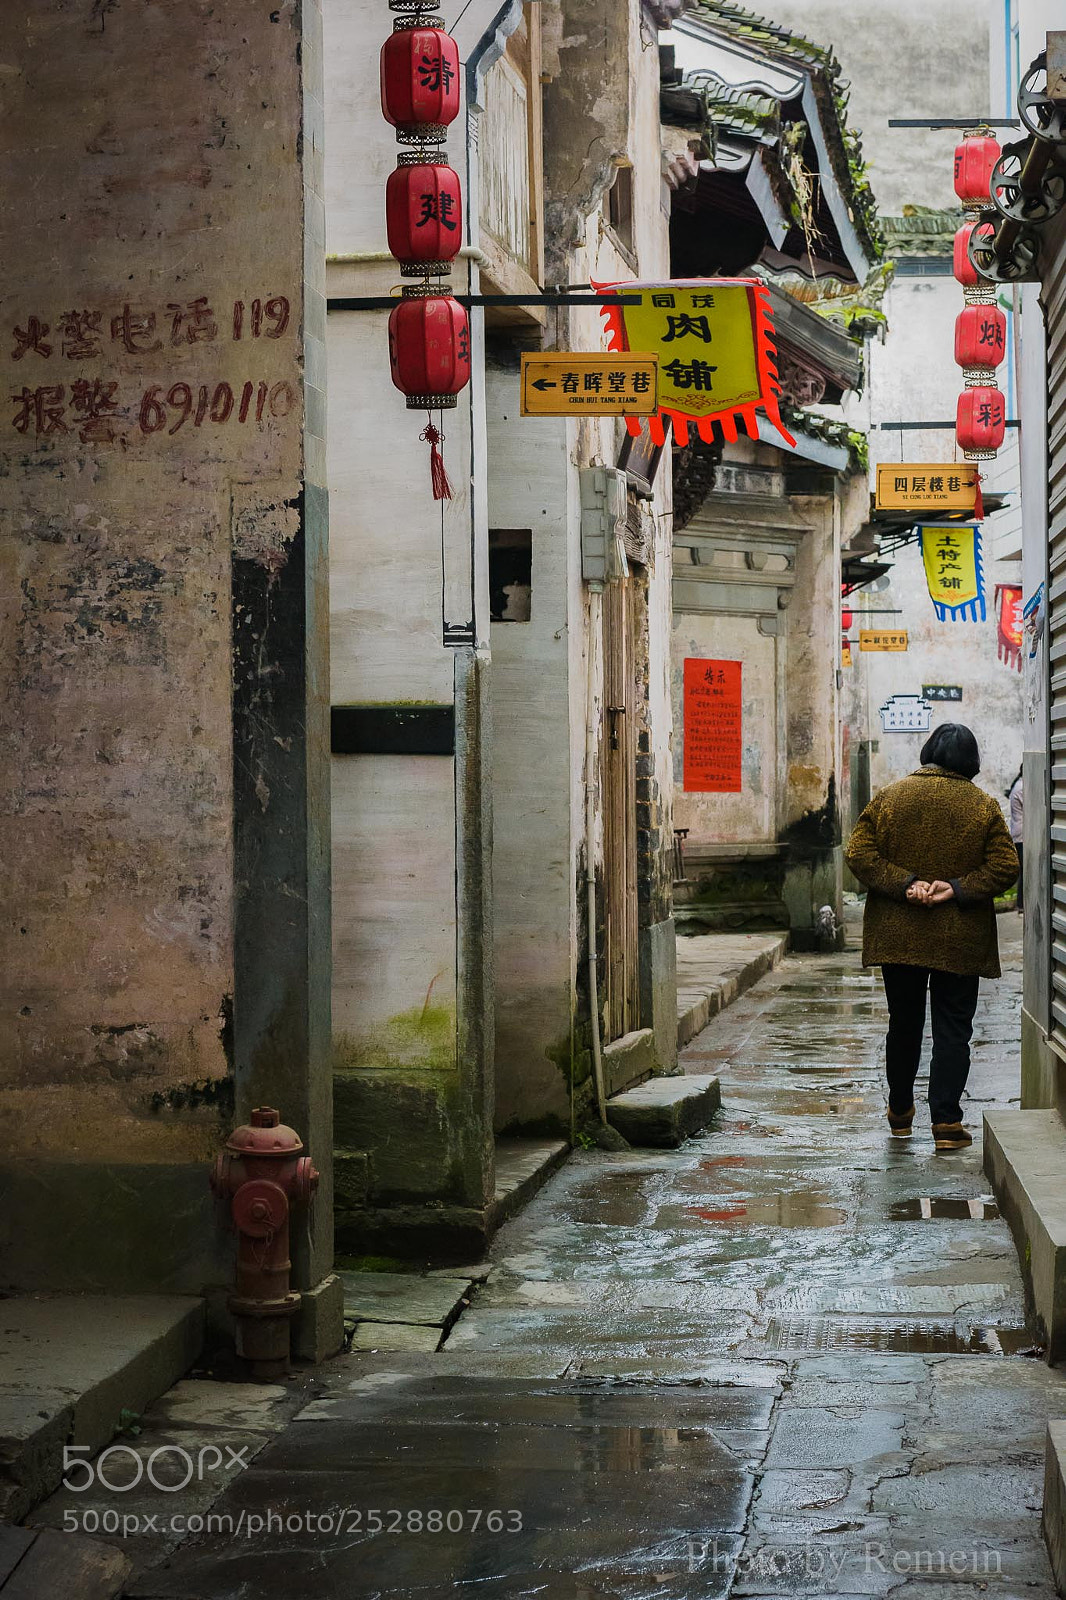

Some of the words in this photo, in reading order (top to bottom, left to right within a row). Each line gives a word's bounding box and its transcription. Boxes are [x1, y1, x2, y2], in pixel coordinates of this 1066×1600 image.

[416, 191, 457, 231] 建
[11, 296, 219, 361] 火警电话
[232, 296, 290, 341] 119
[661, 313, 718, 391] 肉铺
[560, 372, 651, 394] 春晖堂巷
[568, 396, 585, 404] CHUN
[586, 396, 598, 404] HUI
[600, 396, 616, 404] TANG
[617, 396, 638, 404] XIANG
[11, 378, 119, 443] 报警
[976, 403, 1002, 428] 彩
[894, 476, 961, 493] 四层楼巷
[935, 535, 963, 590] 土特产铺
